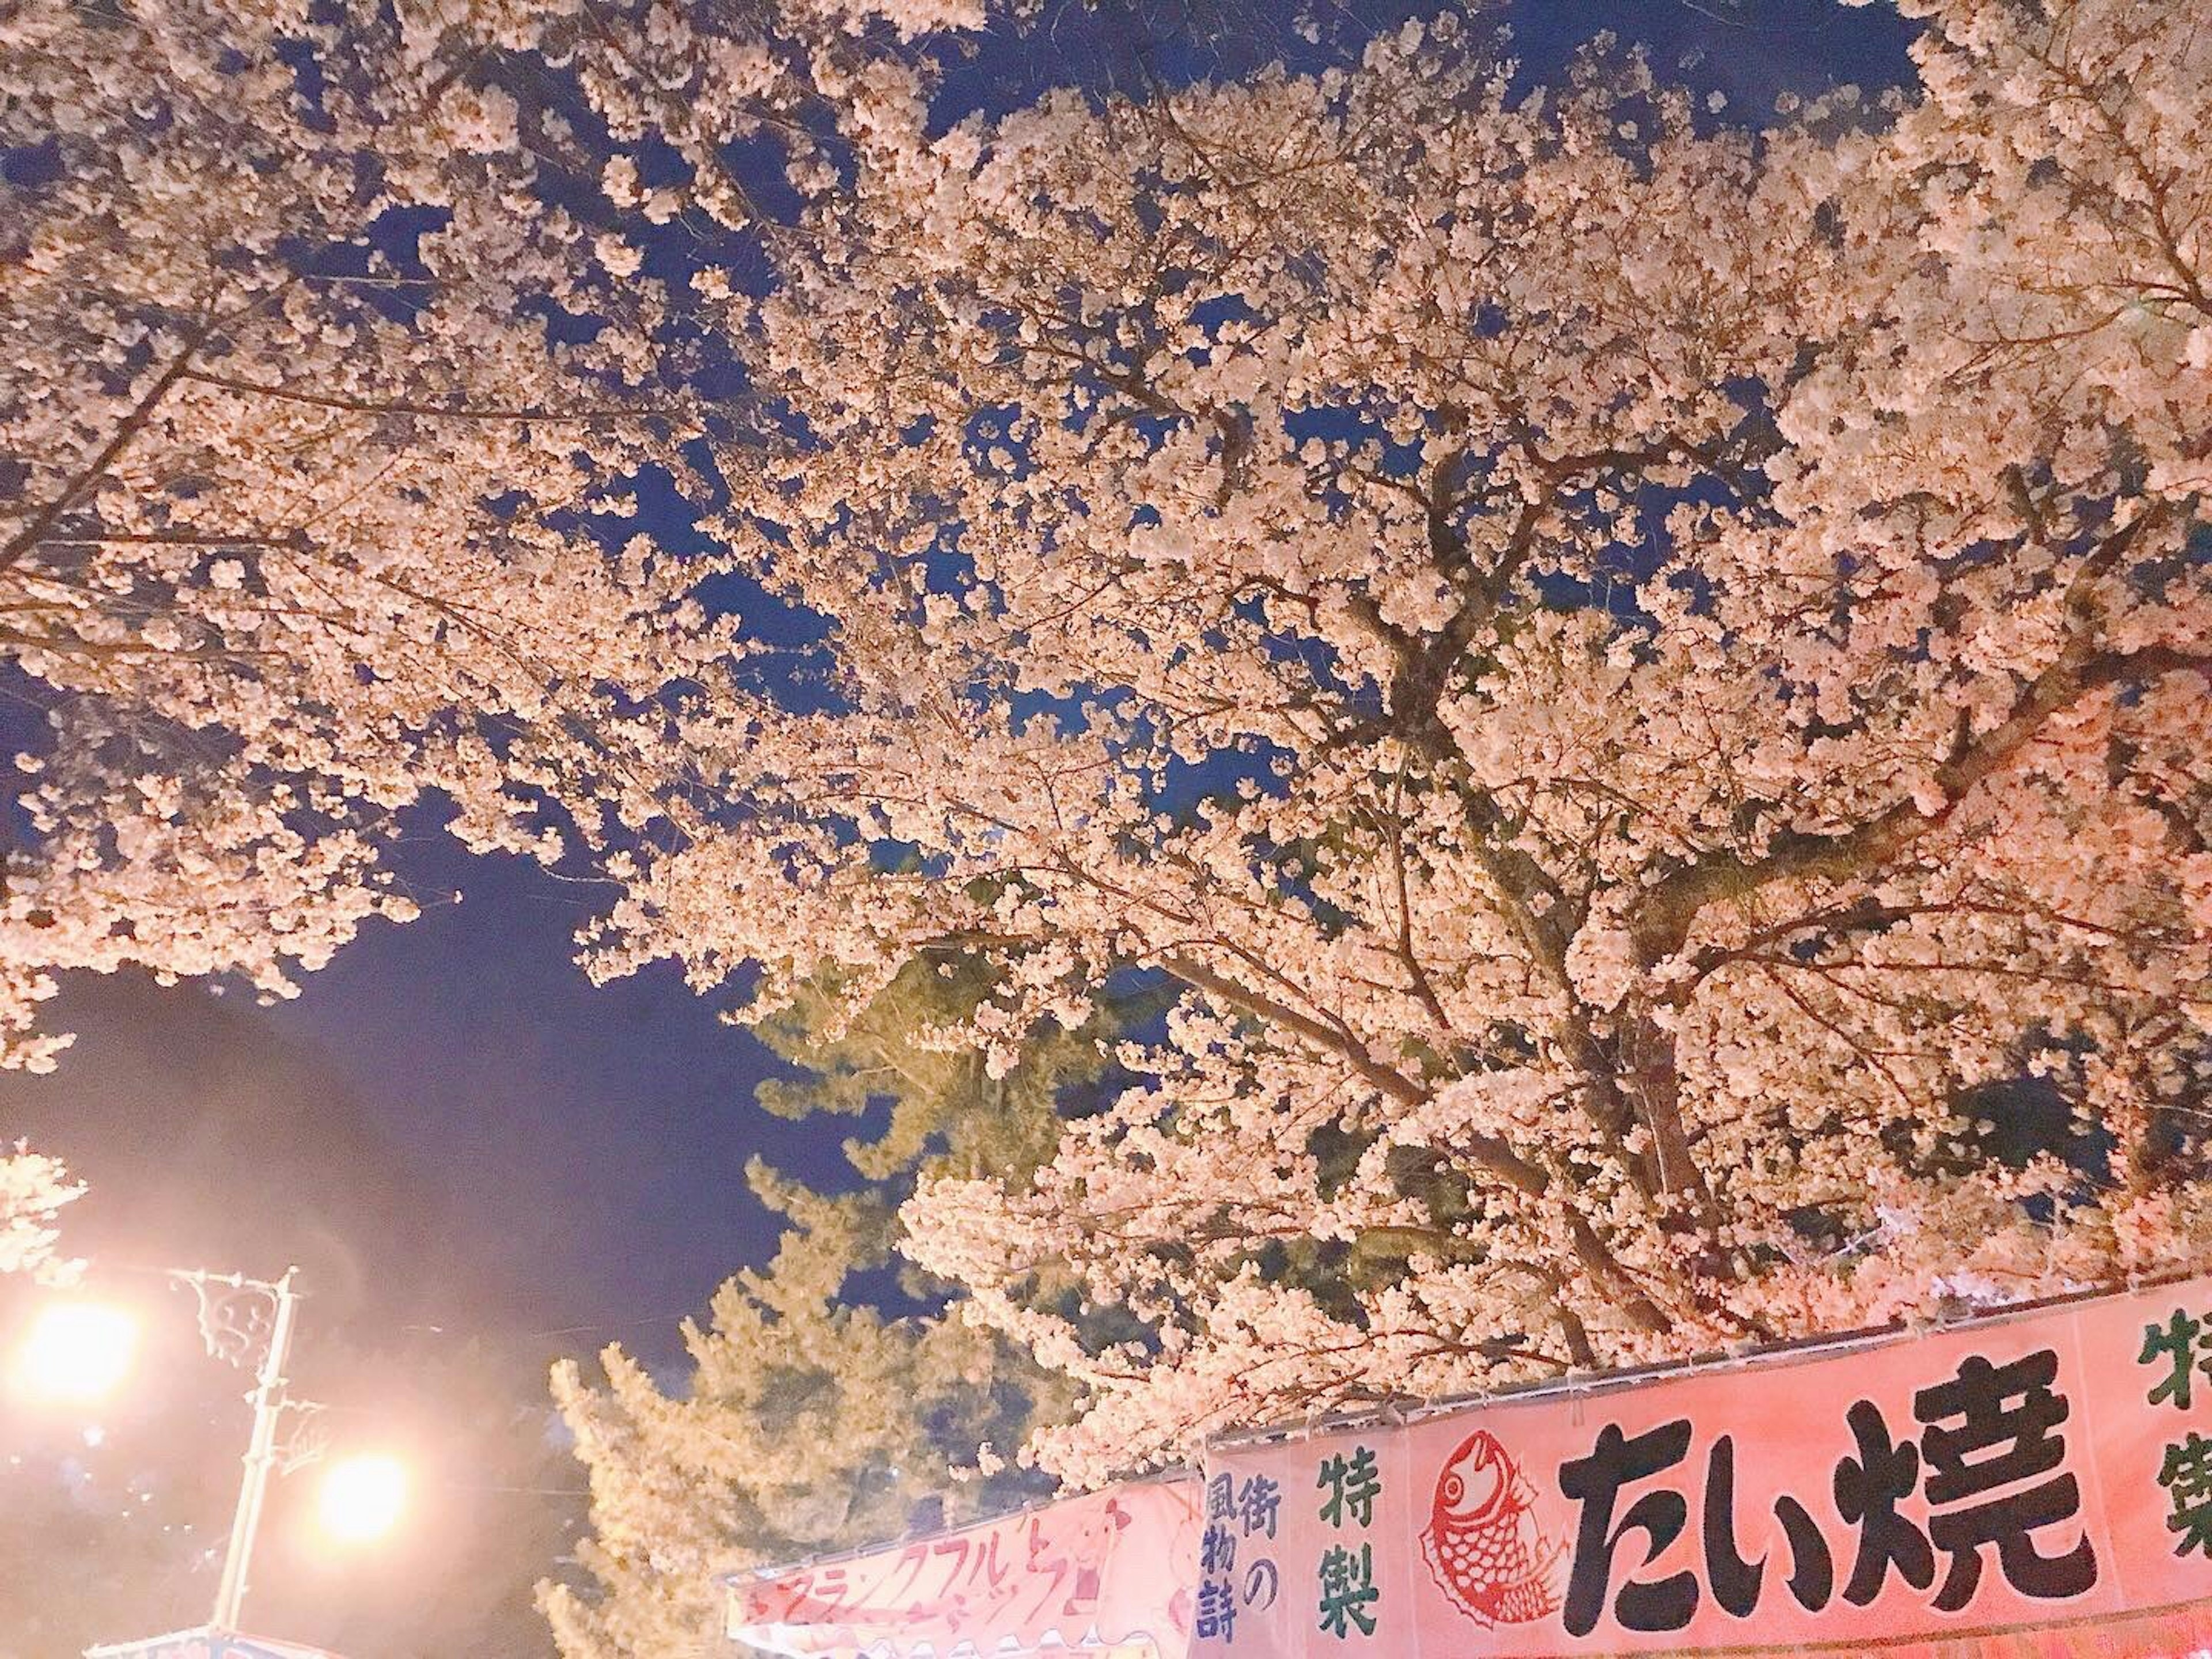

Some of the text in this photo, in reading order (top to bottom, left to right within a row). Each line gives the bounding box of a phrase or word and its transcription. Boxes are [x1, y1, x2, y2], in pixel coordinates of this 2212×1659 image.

[1197, 1472, 1237, 1643] 風物詩
[1238, 1474, 1282, 1611] 街の
[1316, 1445, 1381, 1639] 特製
[1559, 1349, 2097, 1636] たい焼
